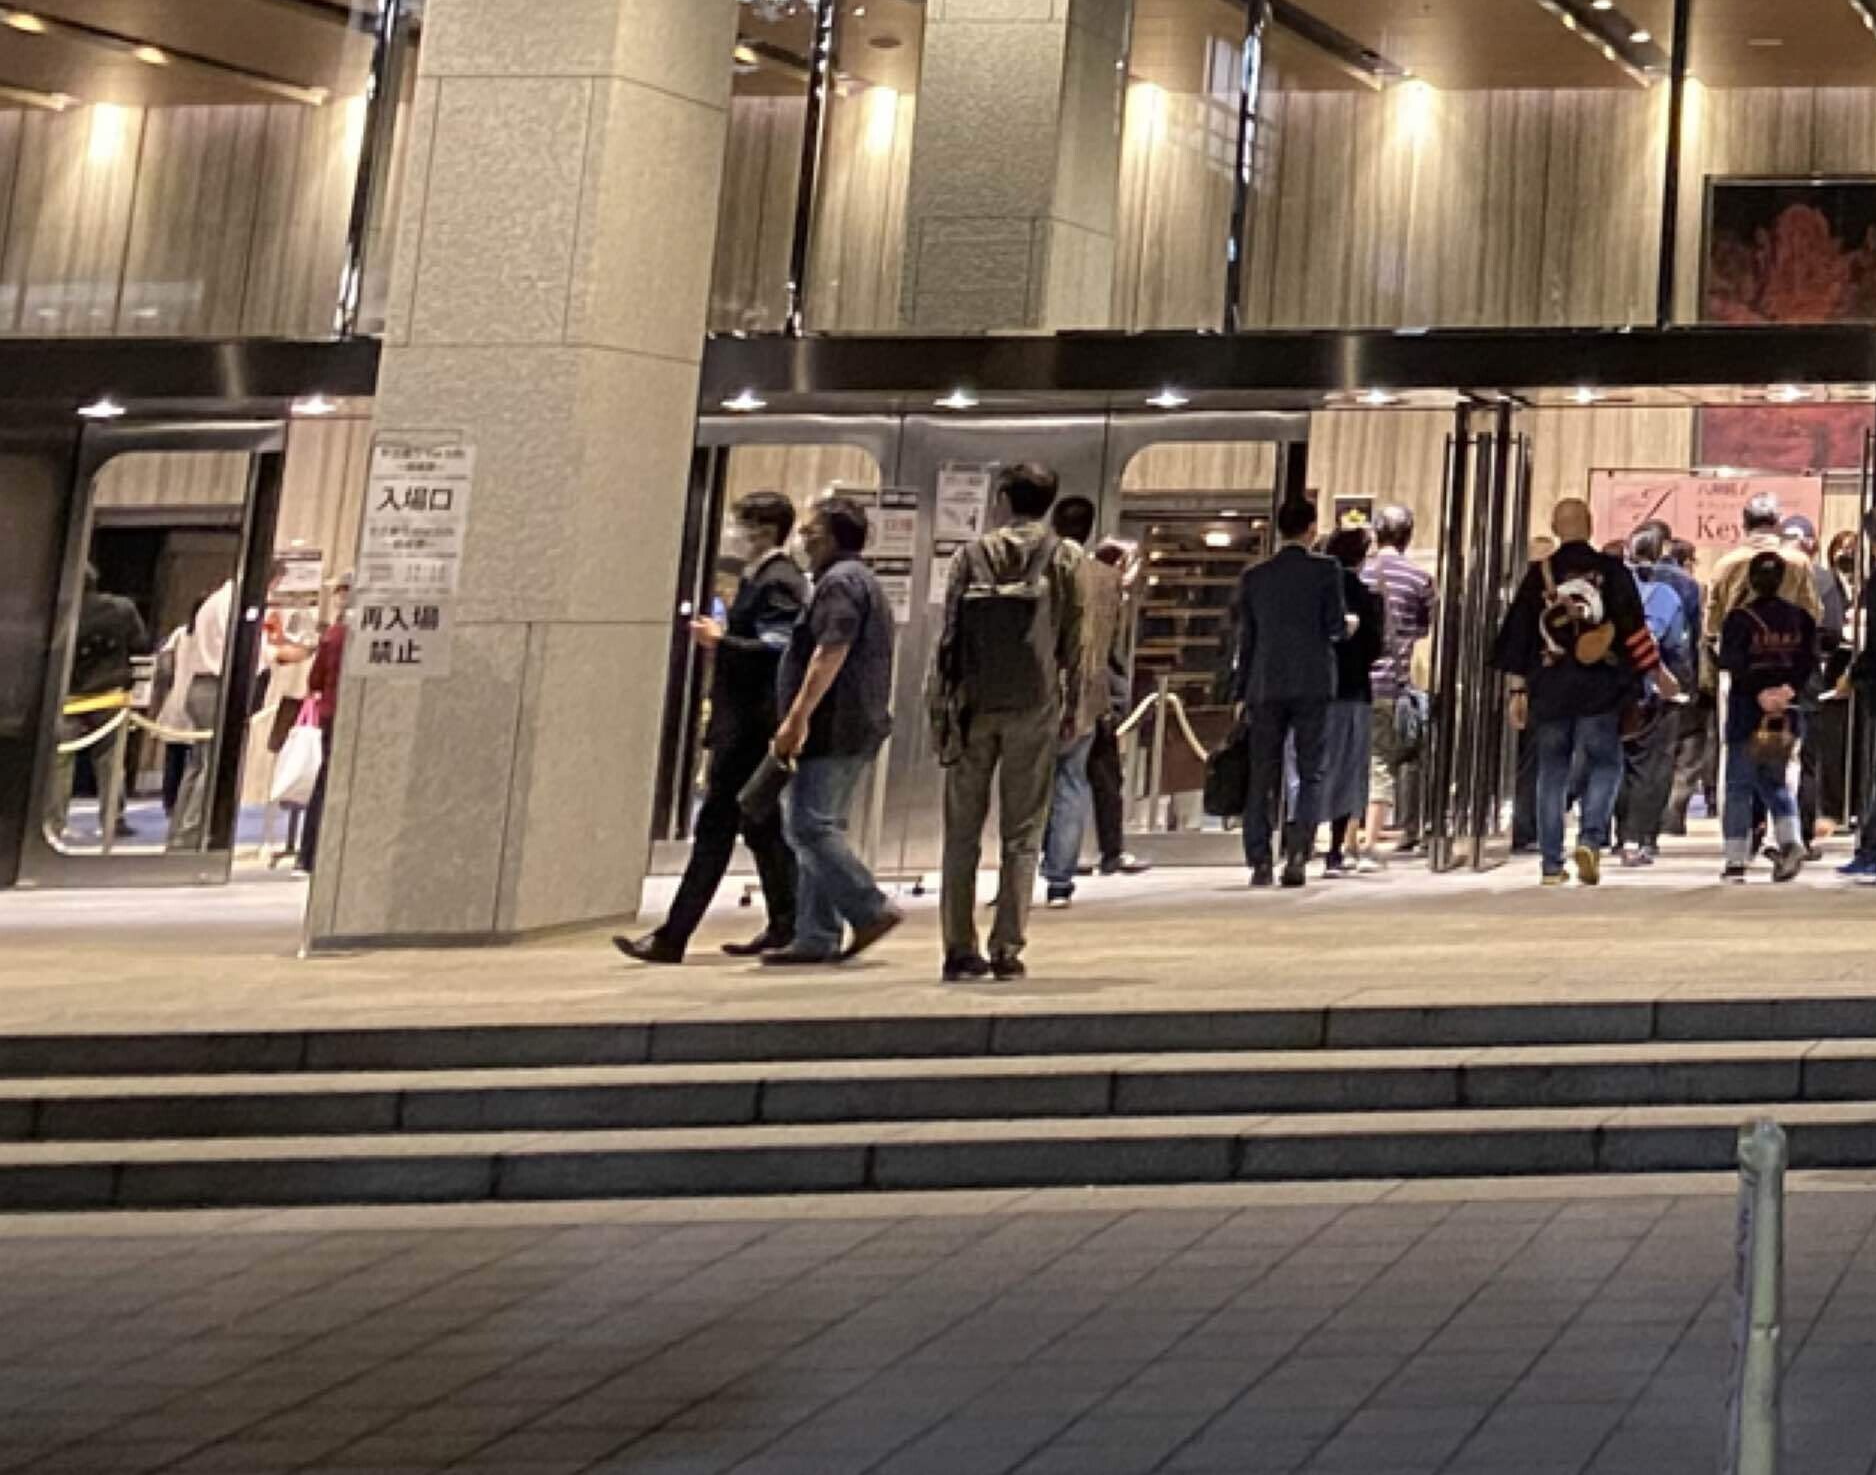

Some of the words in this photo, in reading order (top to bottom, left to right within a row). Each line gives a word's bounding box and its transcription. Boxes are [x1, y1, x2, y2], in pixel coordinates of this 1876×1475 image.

[376, 485, 453, 511] 入場口
[360, 605, 439, 630] 再入場
[369, 638, 421, 663] 禁止
